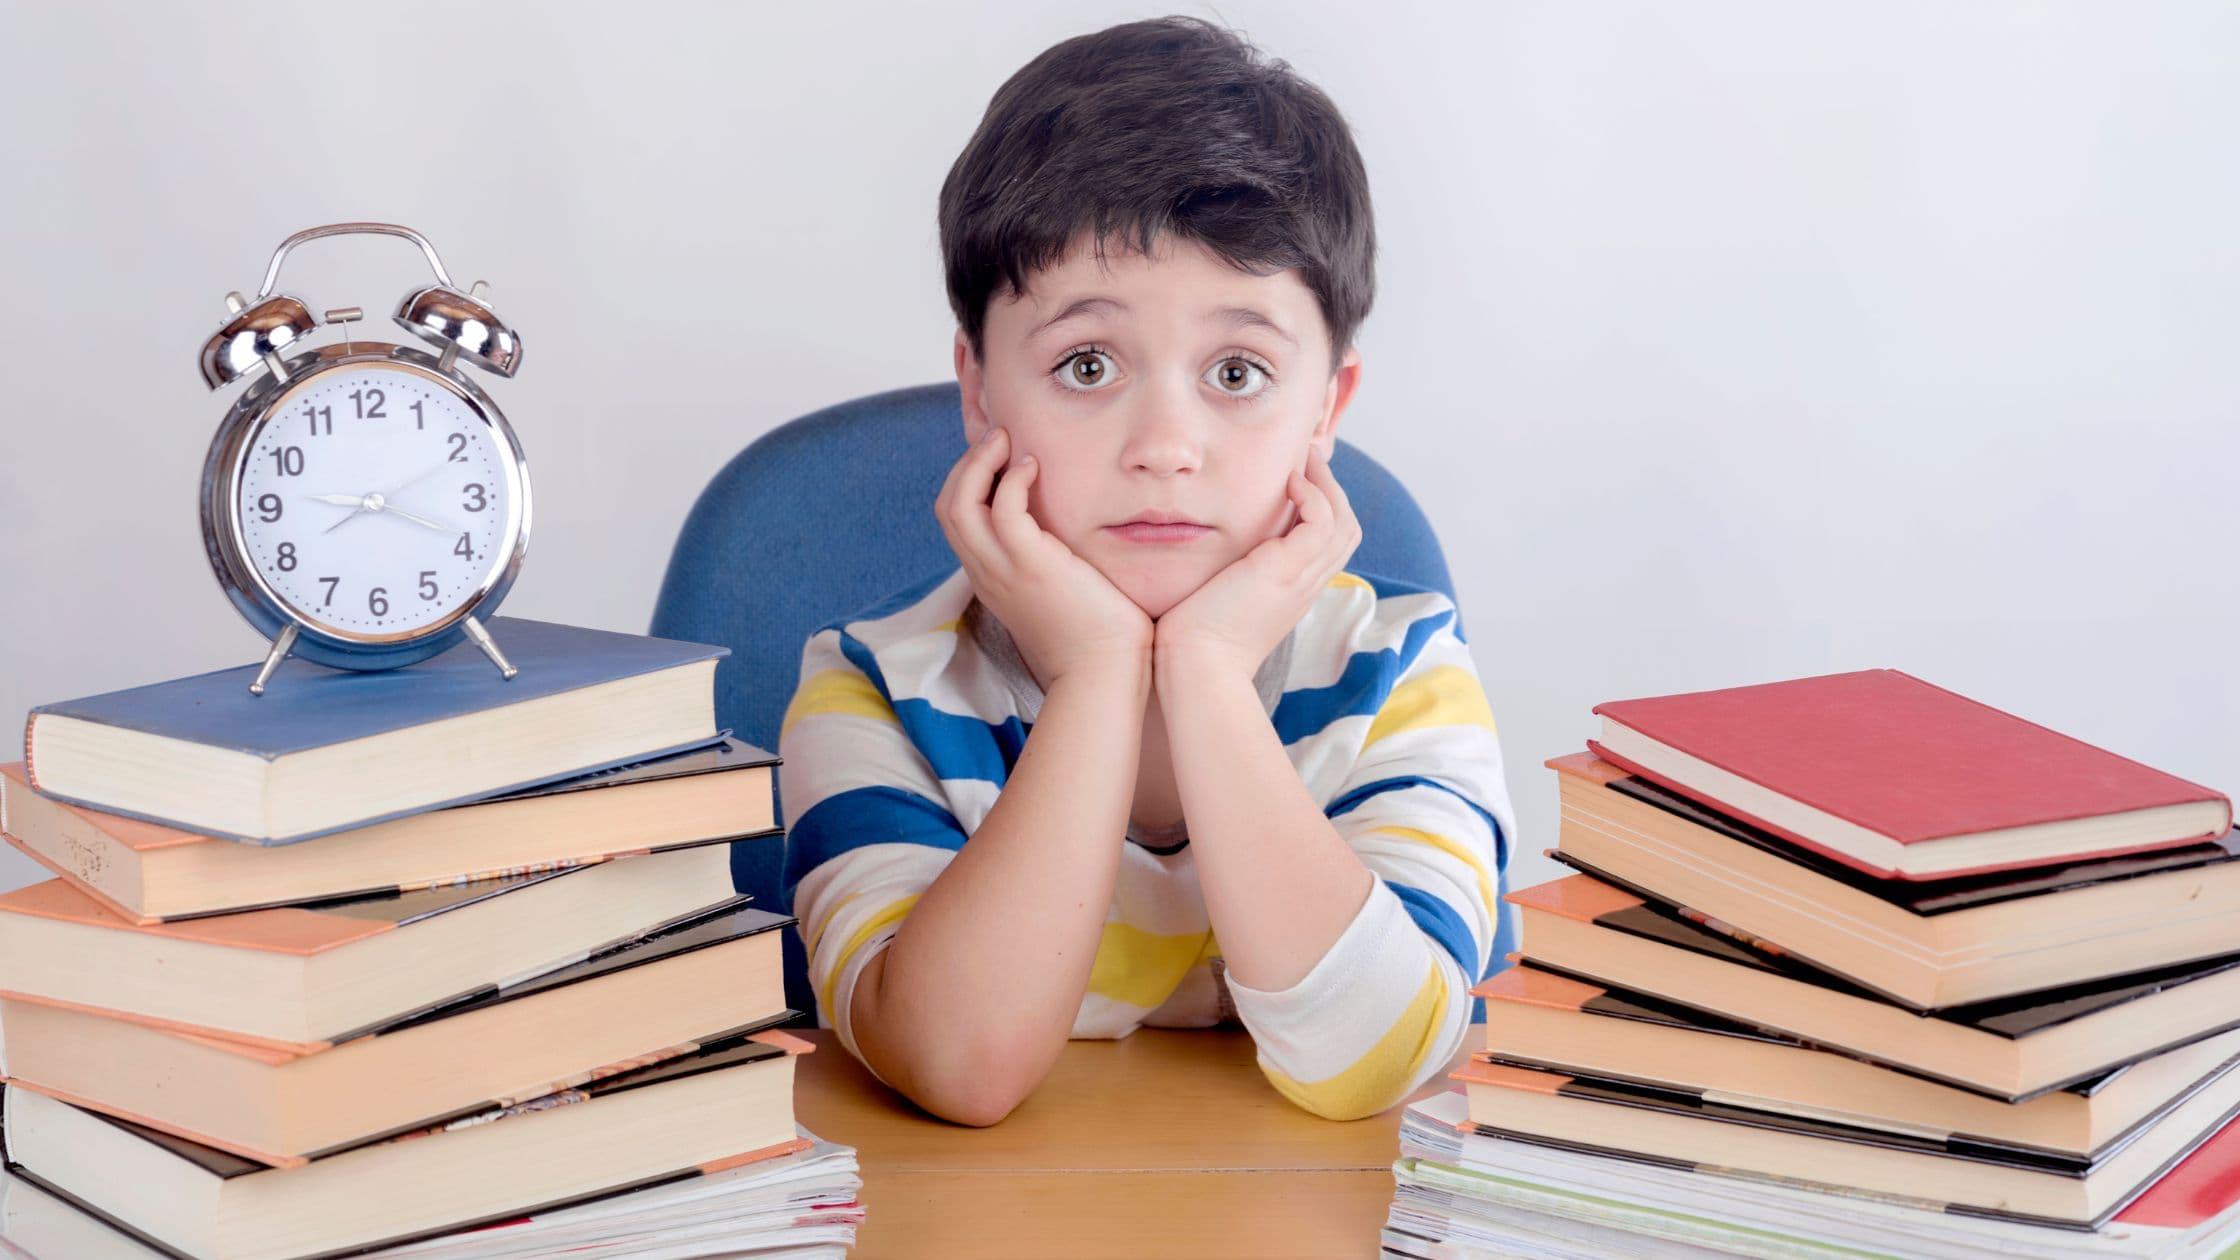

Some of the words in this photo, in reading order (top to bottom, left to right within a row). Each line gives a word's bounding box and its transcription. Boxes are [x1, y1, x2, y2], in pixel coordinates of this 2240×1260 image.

[349, 389, 386, 419] 12
[410, 400, 423, 429] 1
[302, 406, 332, 436] 11
[269, 446, 304, 477] 10
[448, 433, 468, 462] 2
[257, 493, 283, 523] 9
[463, 483, 487, 512] 3
[277, 542, 297, 572] 8
[454, 532, 474, 561] 4
[319, 576, 340, 607] 7
[419, 571, 438, 600] 5
[369, 587, 389, 616] 6
